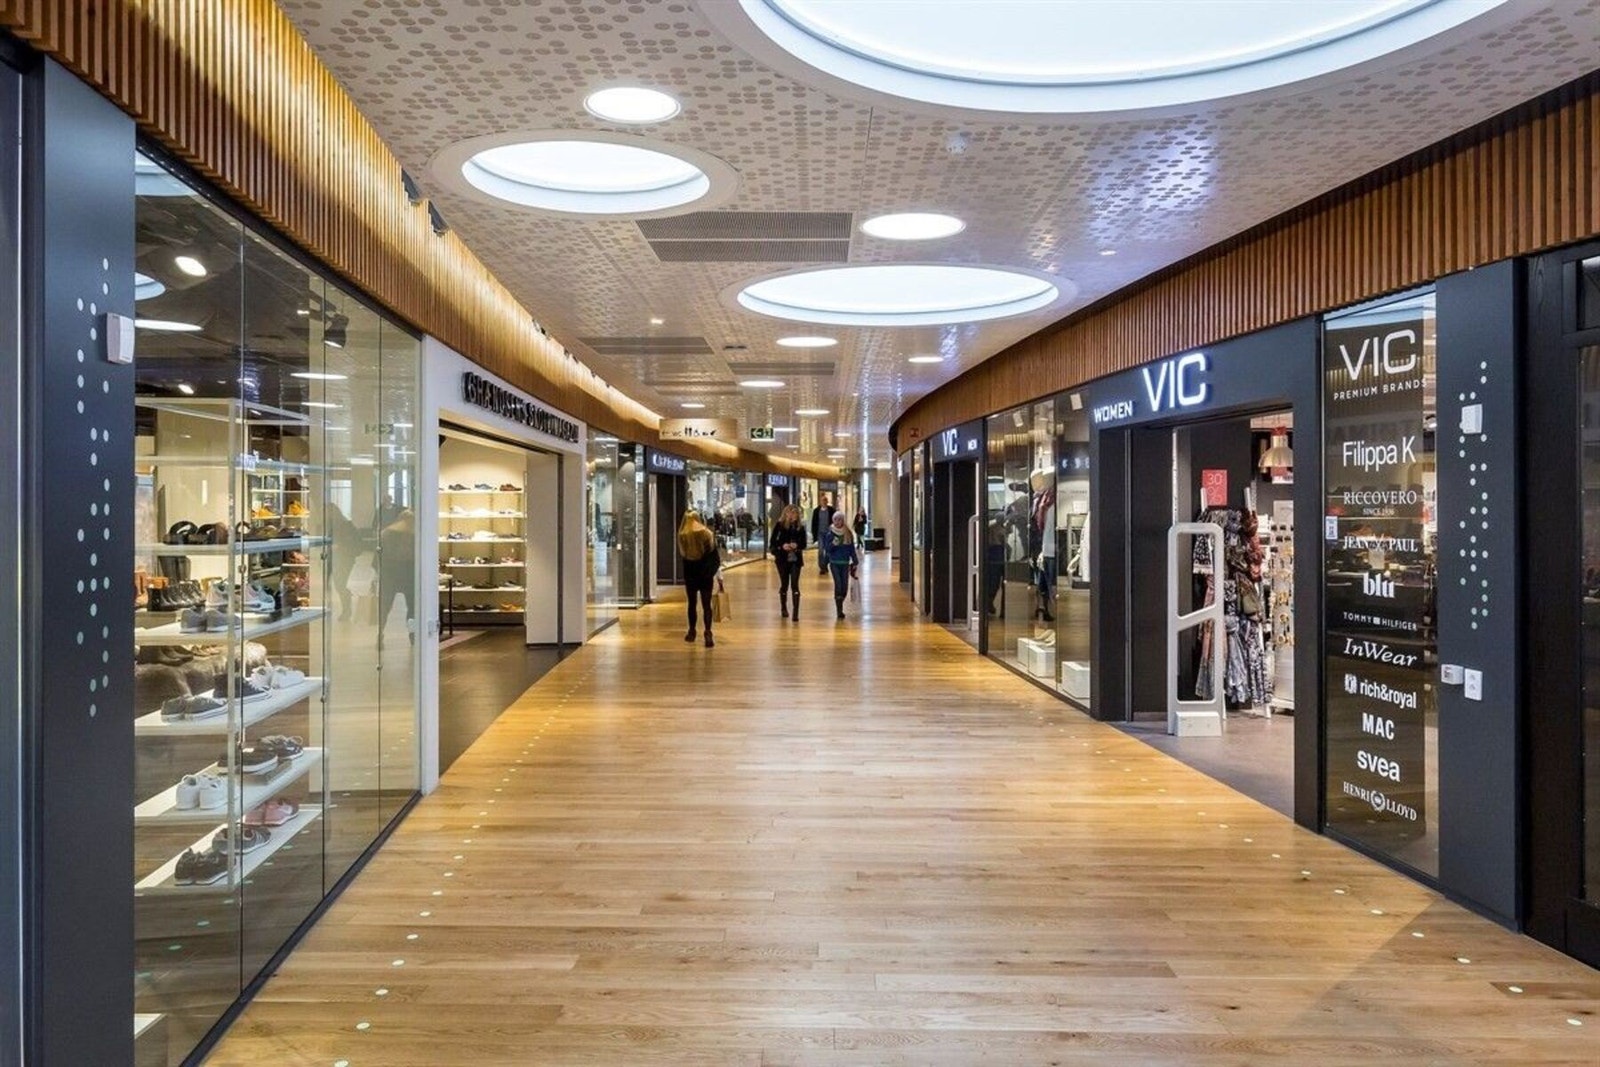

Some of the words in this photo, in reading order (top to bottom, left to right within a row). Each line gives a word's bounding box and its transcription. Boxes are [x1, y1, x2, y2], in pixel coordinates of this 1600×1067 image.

[1340, 329, 1416, 380] VIC
[1142, 352, 1206, 412] VIC
[1333, 386, 1378, 401] PREMIUM
[1382, 378, 1427, 394] BRANDS
[1093, 400, 1133, 423] WOMEN
[942, 428, 958, 456] VIC
[1343, 440, 1397, 472] Filippa
[1402, 435, 1416, 463] K
[1207, 473, 1222, 485] 30
[1343, 490, 1417, 505] RICCOVERO
[1343, 535, 1369, 550] JEAN
[1388, 537, 1418, 552] PAUL
[1363, 572, 1395, 598] blu
[1343, 611, 1371, 624] TOMMY
[1381, 617, 1417, 631] HILFIGER
[1344, 638, 1417, 666] InWear
[1360, 679, 1417, 708] rich&royal
[1362, 712, 1395, 740] MAC
[1357, 750, 1400, 782] svea
[1343, 781, 1370, 802] HENRI
[1386, 799, 1417, 821] LLOYD
